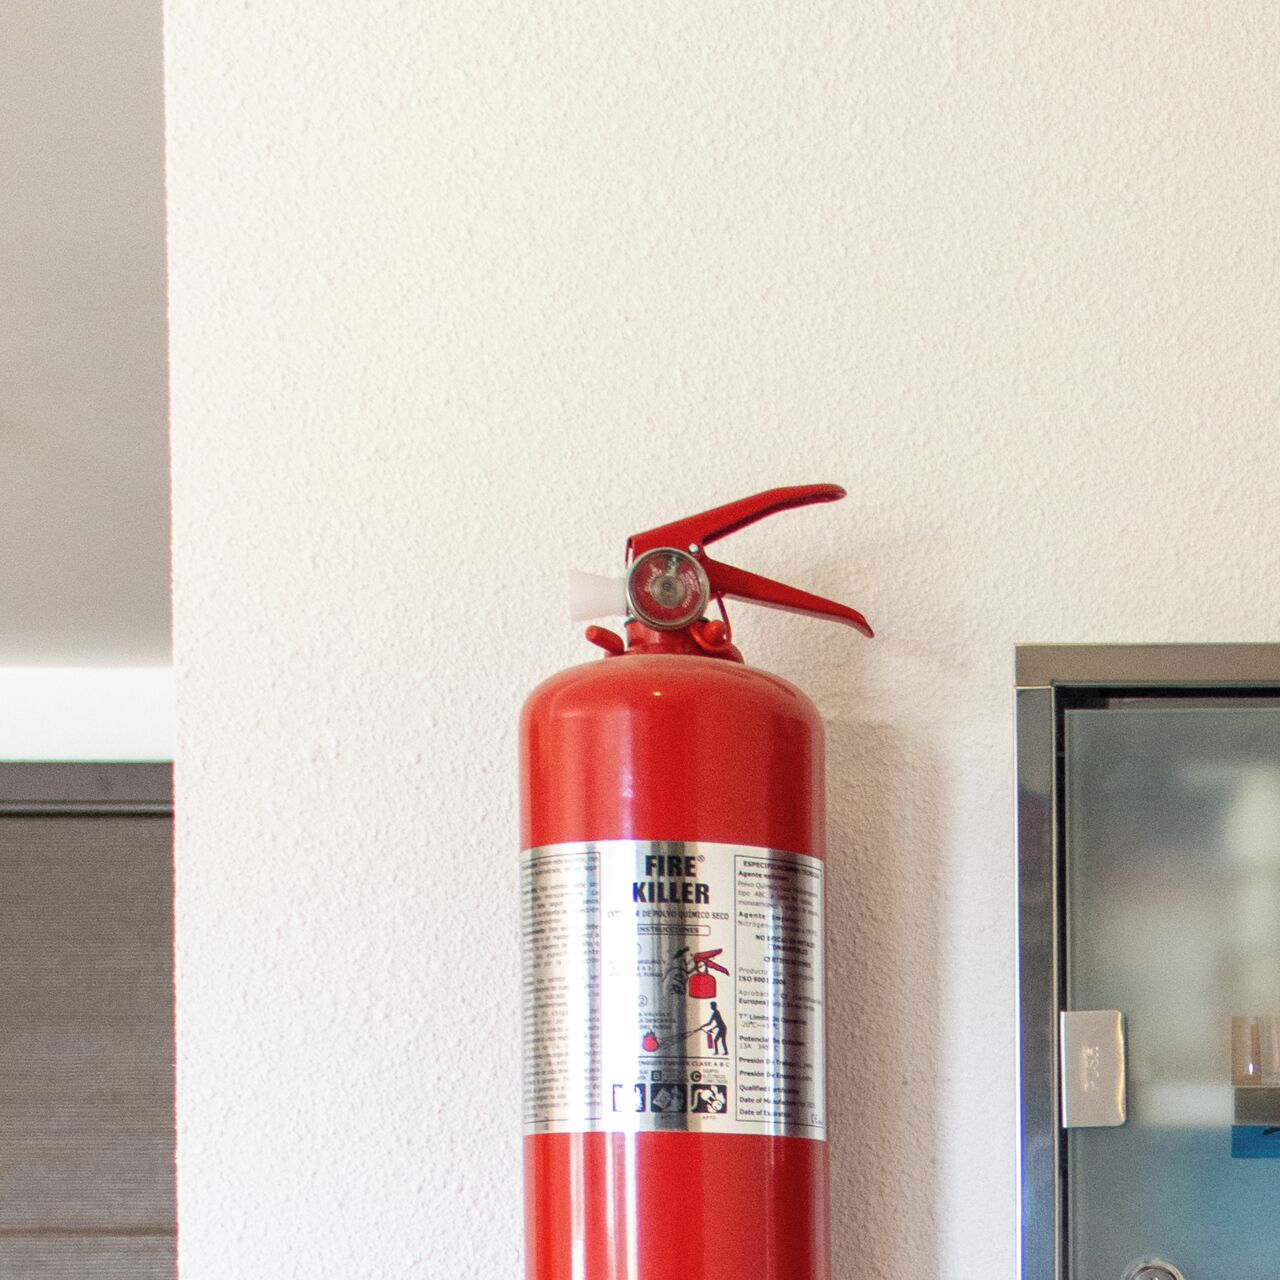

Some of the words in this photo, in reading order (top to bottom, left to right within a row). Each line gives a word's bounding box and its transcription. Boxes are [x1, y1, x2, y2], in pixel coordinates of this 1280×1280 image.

[645, 855, 697, 877] FIRE
[632, 882, 710, 904] KILLER
[712, 912, 730, 921] SECO
